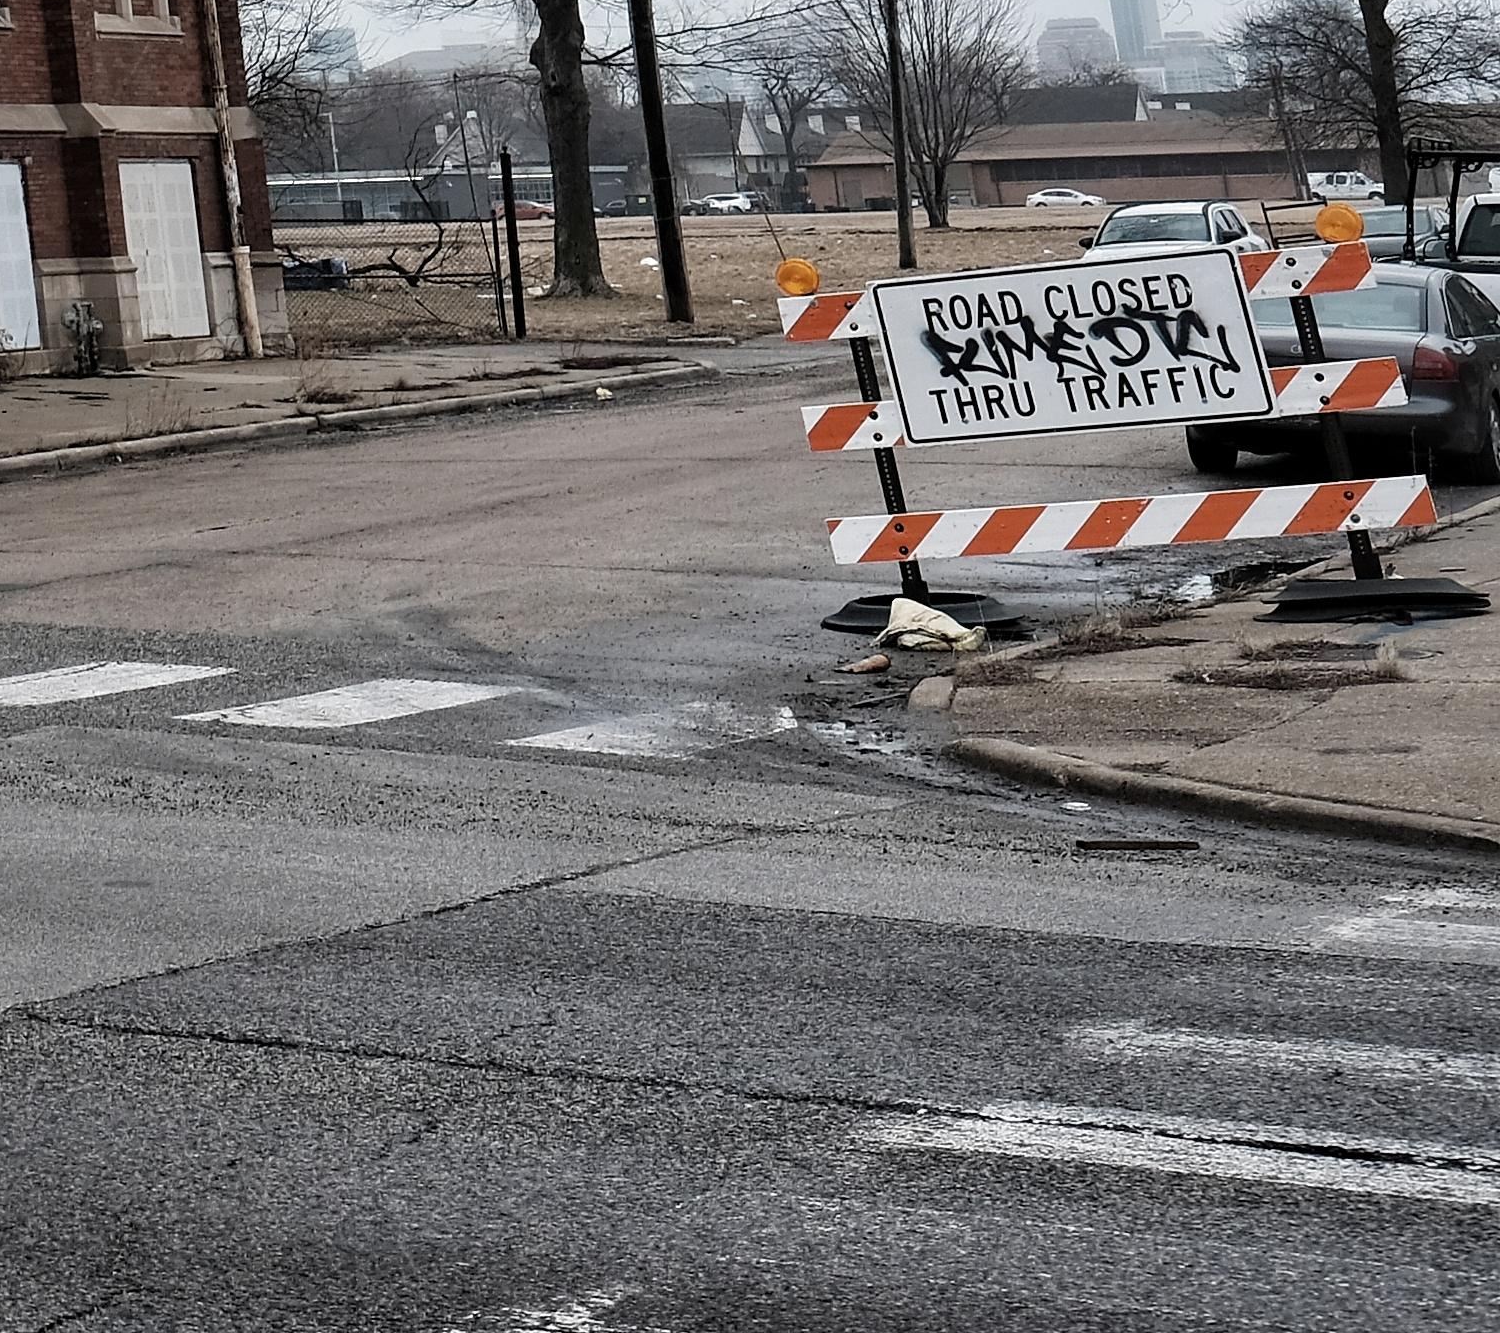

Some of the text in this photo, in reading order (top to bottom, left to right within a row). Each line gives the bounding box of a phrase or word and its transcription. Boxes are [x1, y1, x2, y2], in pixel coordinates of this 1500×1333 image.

[922, 273, 1193, 333] ROAD CLOSED
[929, 364, 1234, 424] THRU TRAFFIC
